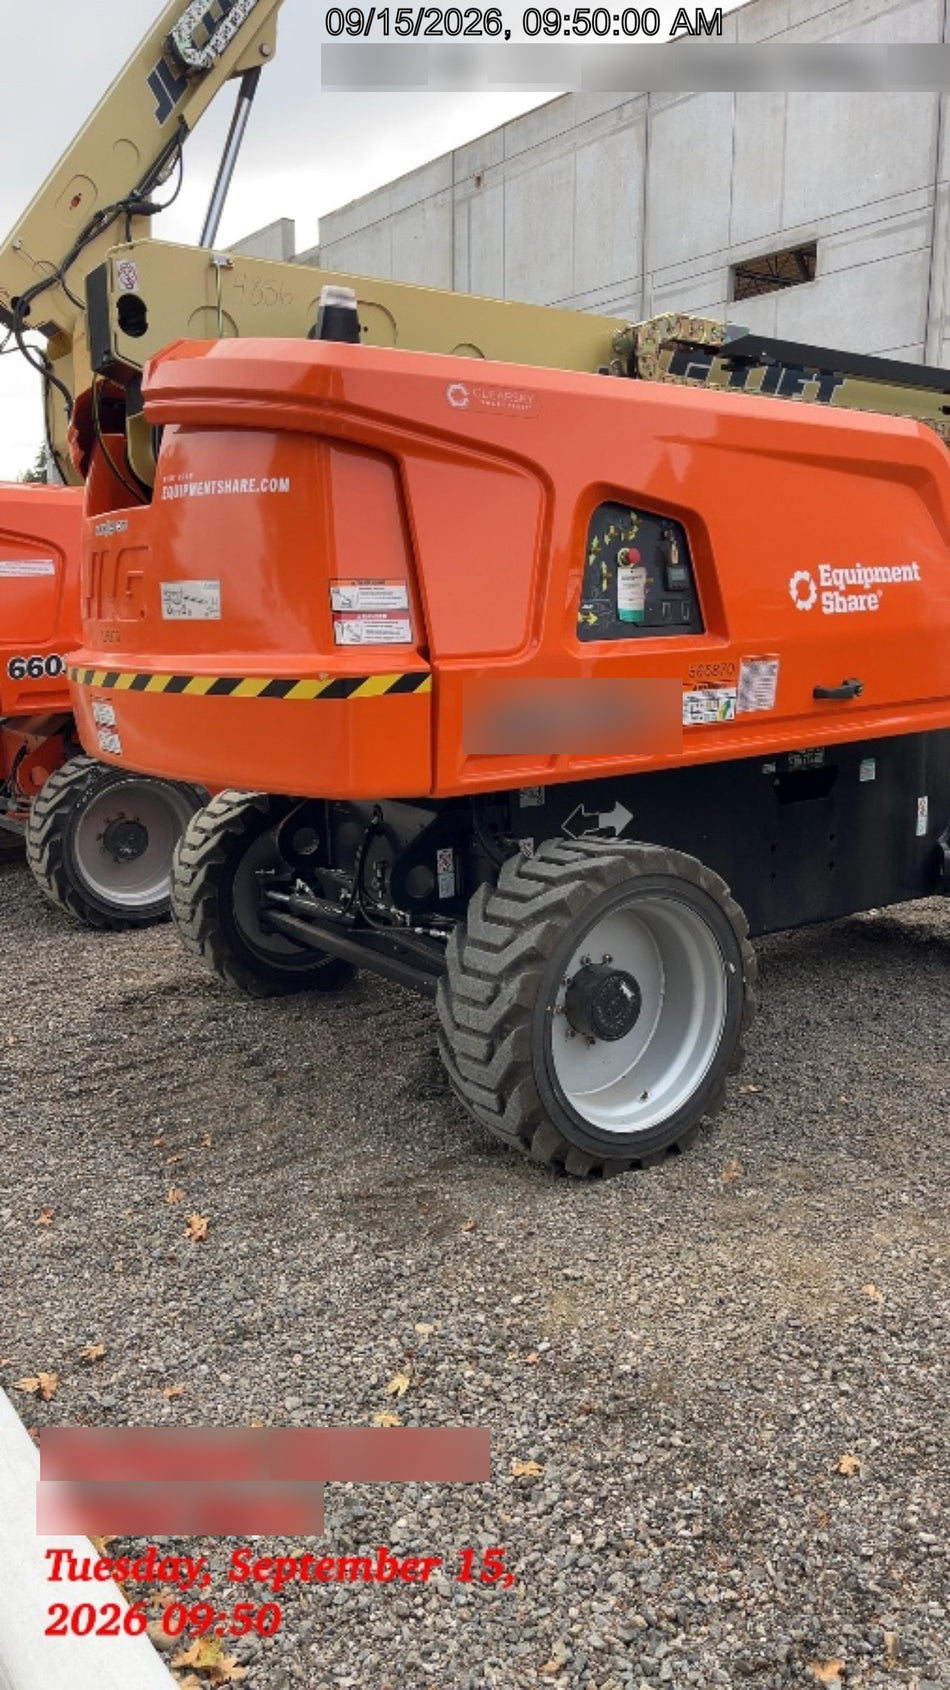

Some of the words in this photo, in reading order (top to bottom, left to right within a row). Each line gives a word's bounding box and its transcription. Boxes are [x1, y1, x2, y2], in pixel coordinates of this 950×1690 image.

[162, 476, 290, 500] EQUIPMENTSHARE.COM
[819, 561, 921, 590] Equipment
[7, 653, 67, 680] 660
